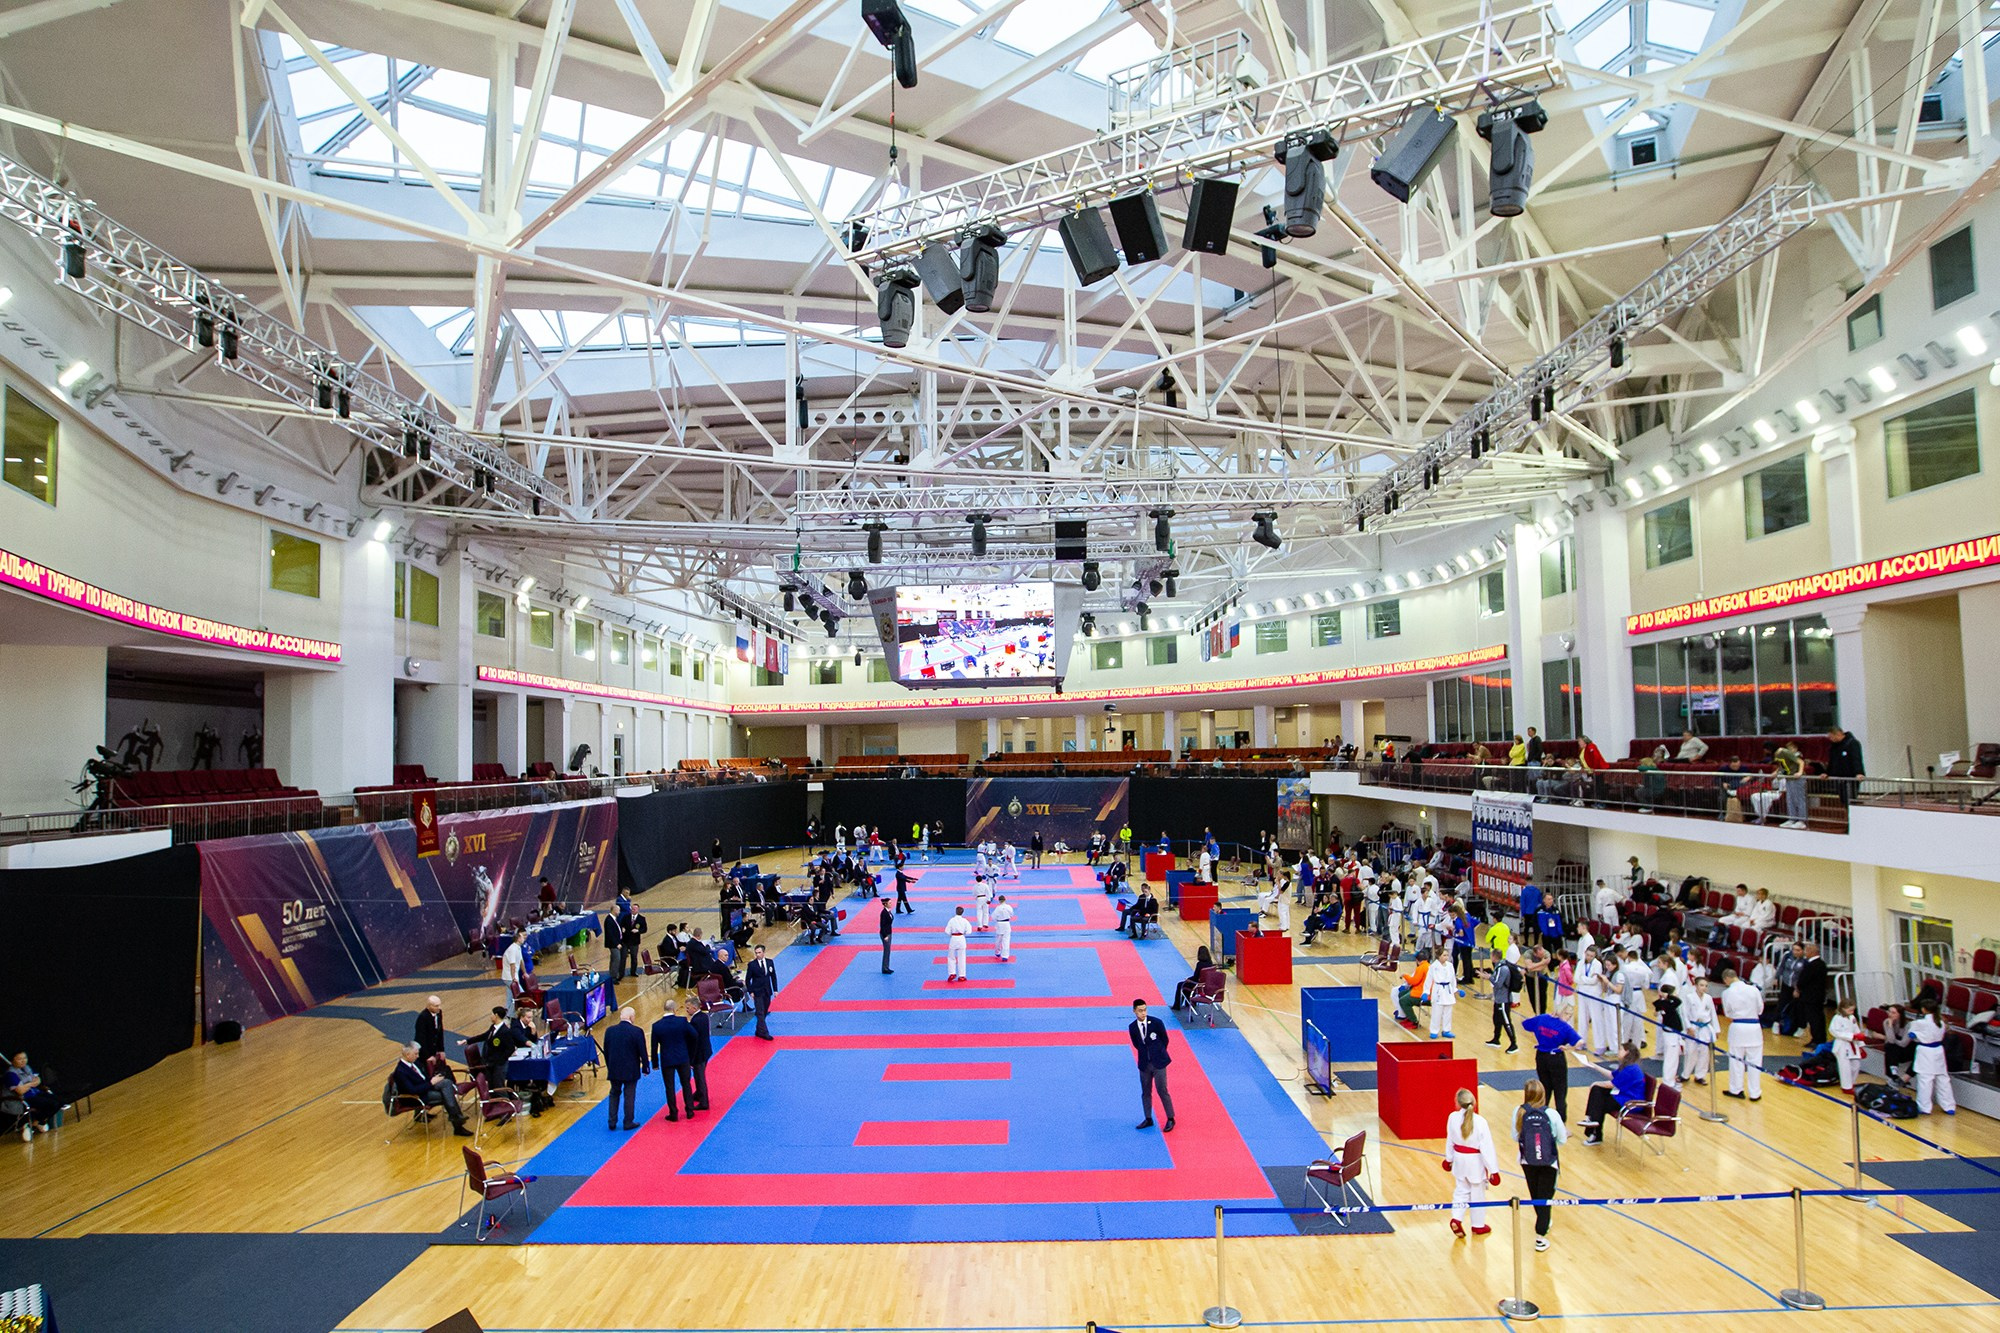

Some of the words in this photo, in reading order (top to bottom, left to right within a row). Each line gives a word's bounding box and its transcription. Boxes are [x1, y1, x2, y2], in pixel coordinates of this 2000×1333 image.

[47, 569, 85, 600] ТУРНИР
[86, 585, 100, 607] ПО
[101, 591, 133, 618] КАРАТЭ
[134, 602, 148, 622] НА
[149, 606, 180, 631] КУБОК
[270, 634, 341, 659] АССОЦИАЦИИ
[1640, 615, 1653, 628] ПО
[1655, 605, 1692, 626] КАРАТЭ
[1692, 602, 1708, 618] НА
[1709, 593, 1747, 615] КУБОК
[488, 667, 497, 679] ПО
[497, 669, 518, 682] КАРАТЭ
[518, 671, 526, 683] НА
[957, 696, 982, 705] ТУРНИР
[983, 696, 993, 704] ПО
[994, 695, 1019, 704] КАРАТЭ
[1019, 694, 1029, 702] НА
[1029, 694, 1050, 702] КУБОК
[1322, 669, 1346, 681] ТУРНИР
[1347, 669, 1357, 679] ПО
[1358, 666, 1383, 678] КАРАТЭ
[1383, 664, 1393, 674] НА
[1394, 661, 1415, 673] КУБОК
[1025, 803, 1050, 816] XVI
[463, 832, 486, 854] XVI
[282, 899, 303, 925] 50
[304, 904, 327, 920] лет
